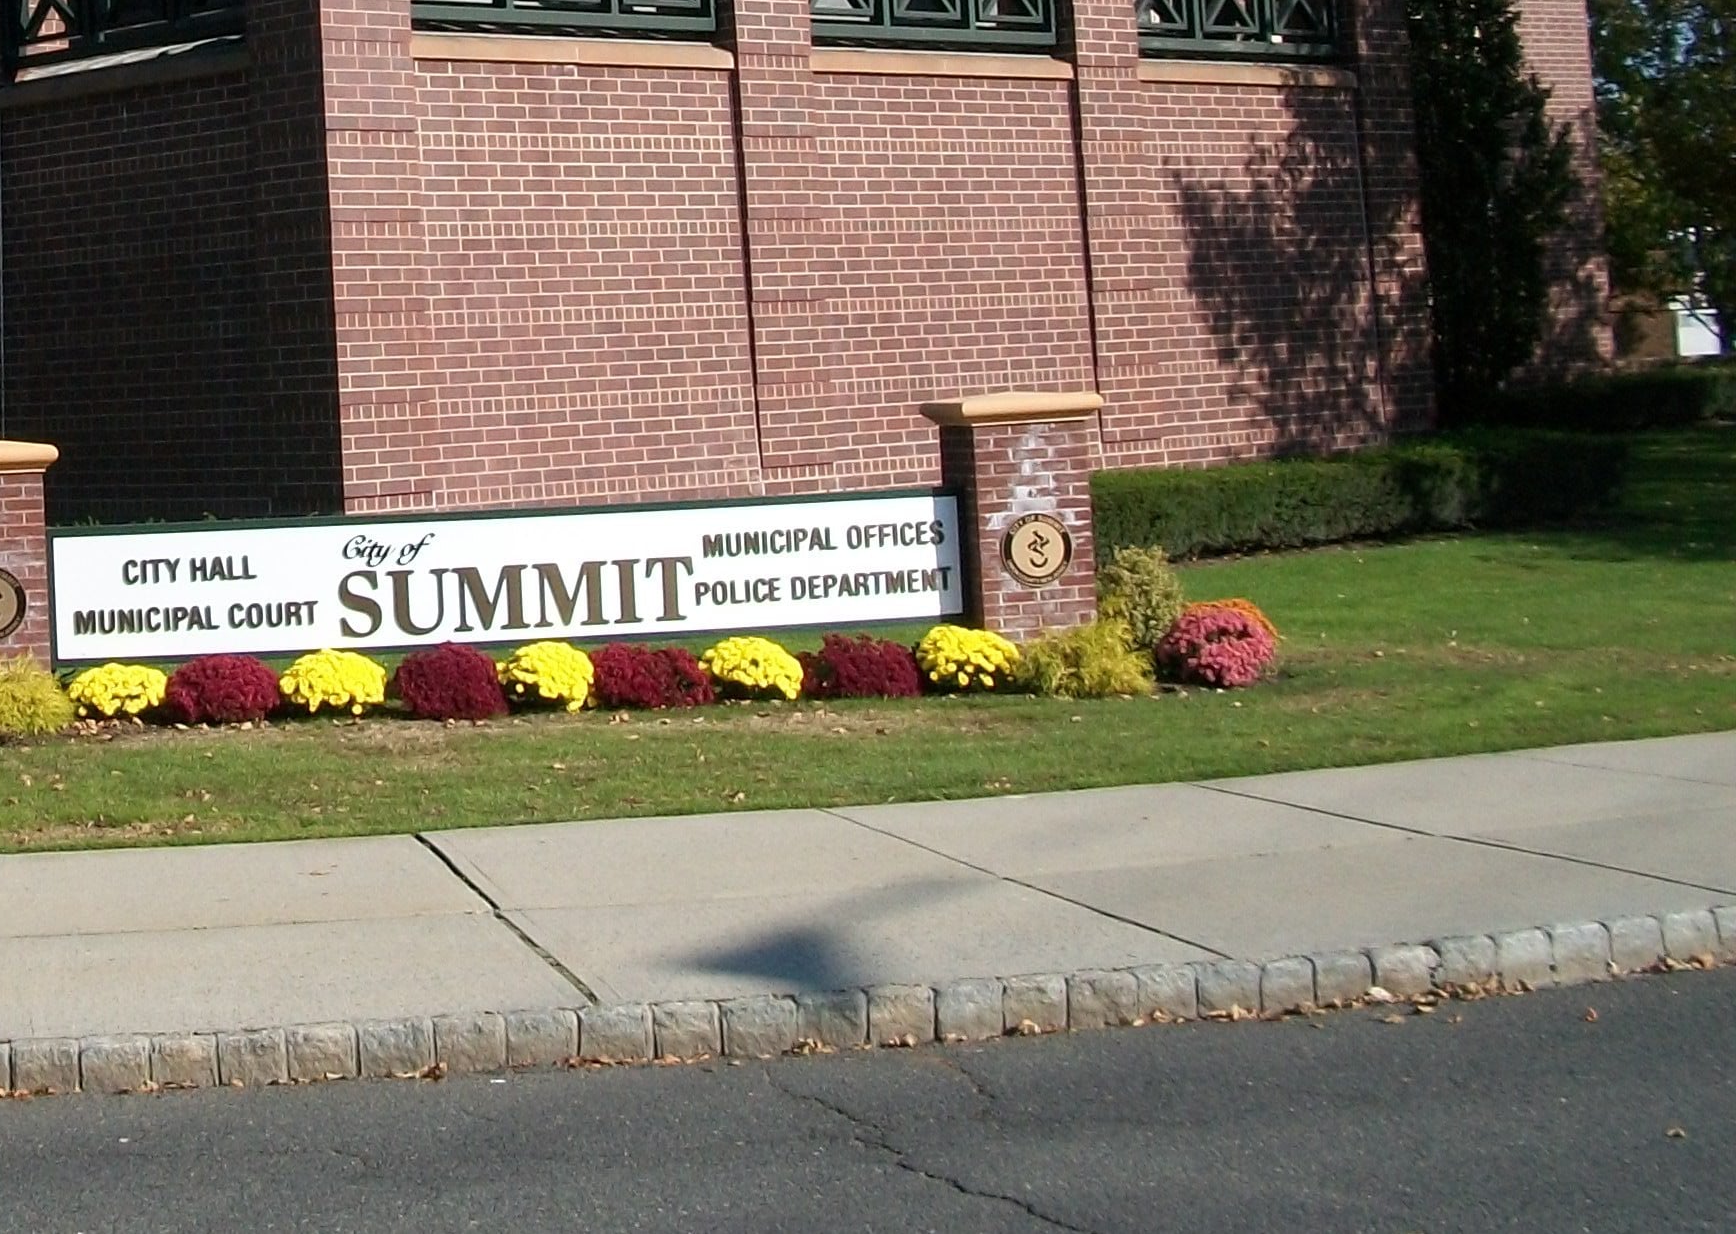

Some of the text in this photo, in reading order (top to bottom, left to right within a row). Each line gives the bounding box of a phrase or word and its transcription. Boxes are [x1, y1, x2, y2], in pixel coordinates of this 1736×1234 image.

[341, 533, 435, 567] City of
[702, 520, 945, 558] MUNICIPAL OFFICES
[122, 555, 257, 585] CITY HALL
[695, 566, 952, 606] POLICE DEPARTMENT
[338, 556, 694, 638] SUMMIT
[73, 600, 318, 635] MUNICIPAL COURT
